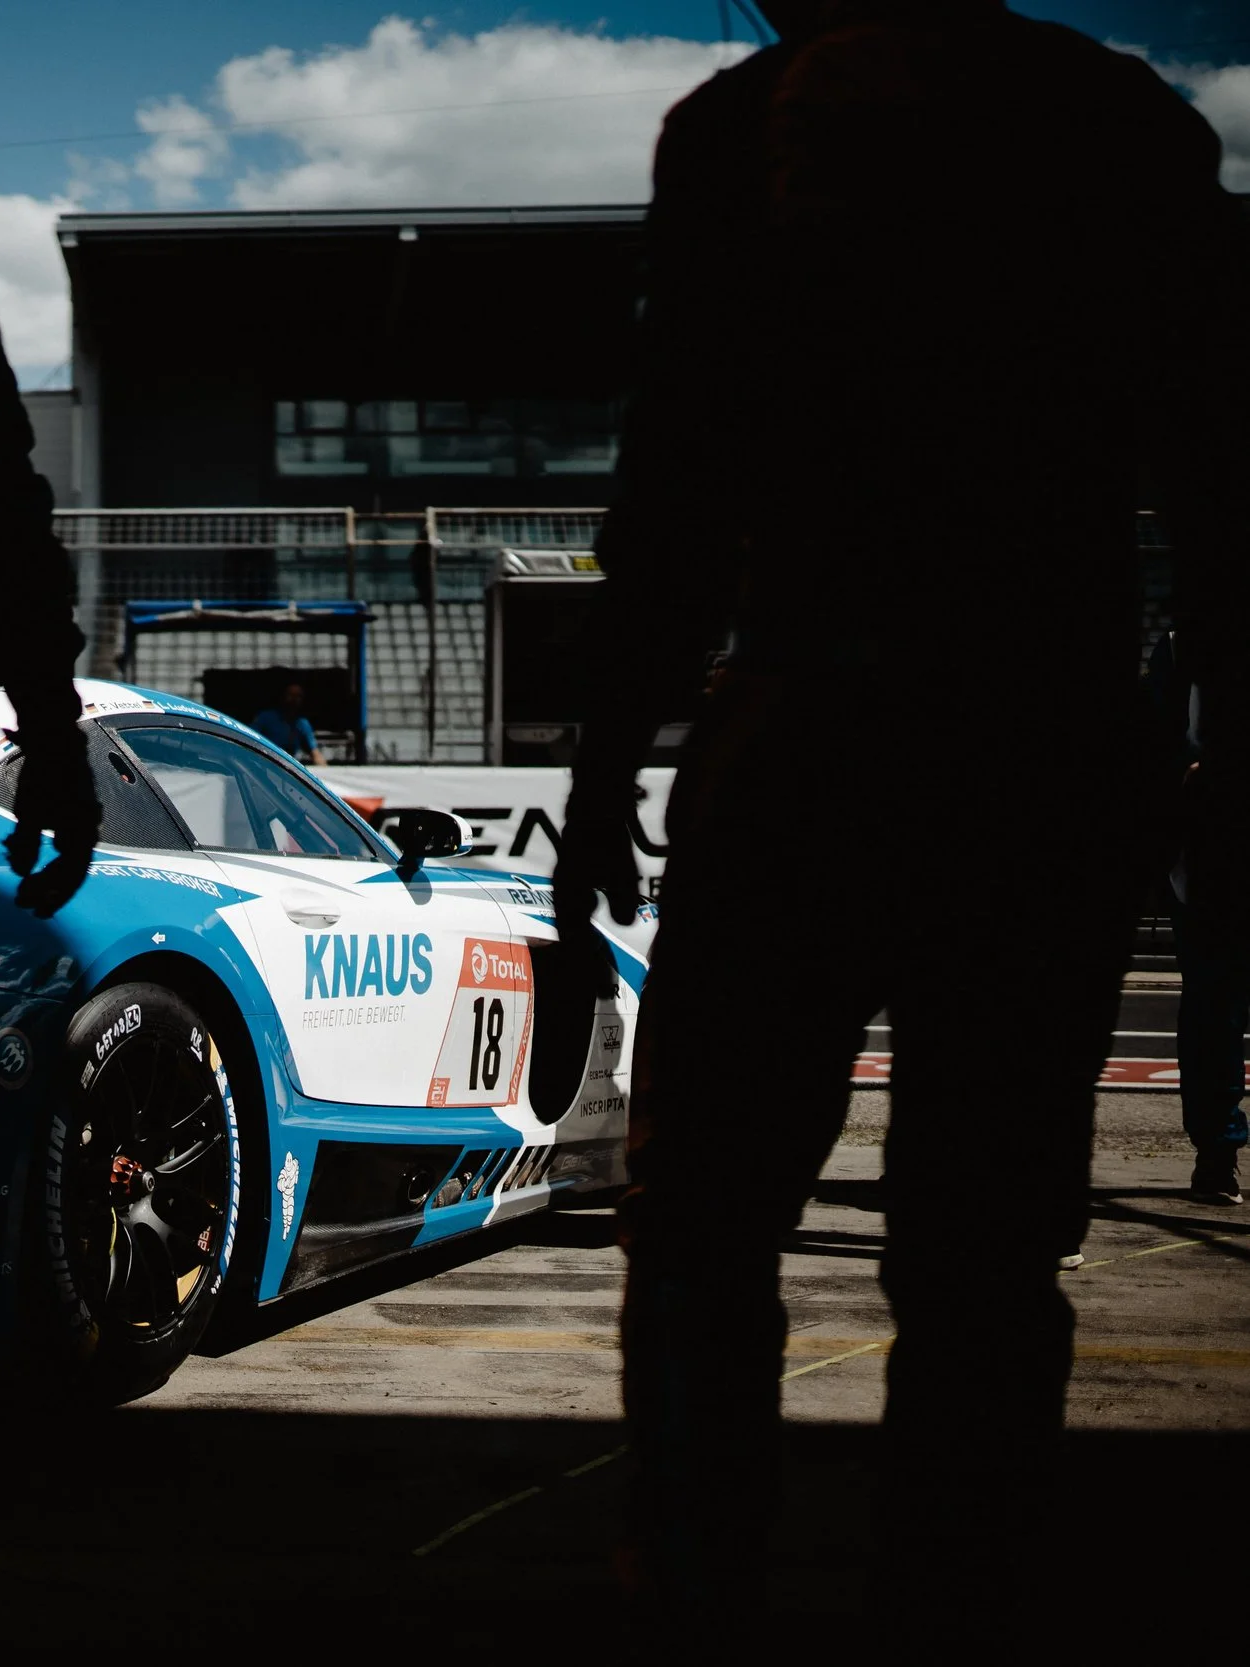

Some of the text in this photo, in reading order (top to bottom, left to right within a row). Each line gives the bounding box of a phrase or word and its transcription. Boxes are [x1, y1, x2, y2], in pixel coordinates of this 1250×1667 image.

[128, 867, 168, 882] CAR
[163, 870, 224, 899] BROKER
[305, 933, 433, 1000] KNAUS
[488, 955, 528, 981] TOTAL
[347, 1008, 363, 1025] DIE
[469, 996, 505, 1091] 18
[580, 1097, 625, 1117] INSCRIPTA
[226, 1097, 241, 1268] MICHELIN
